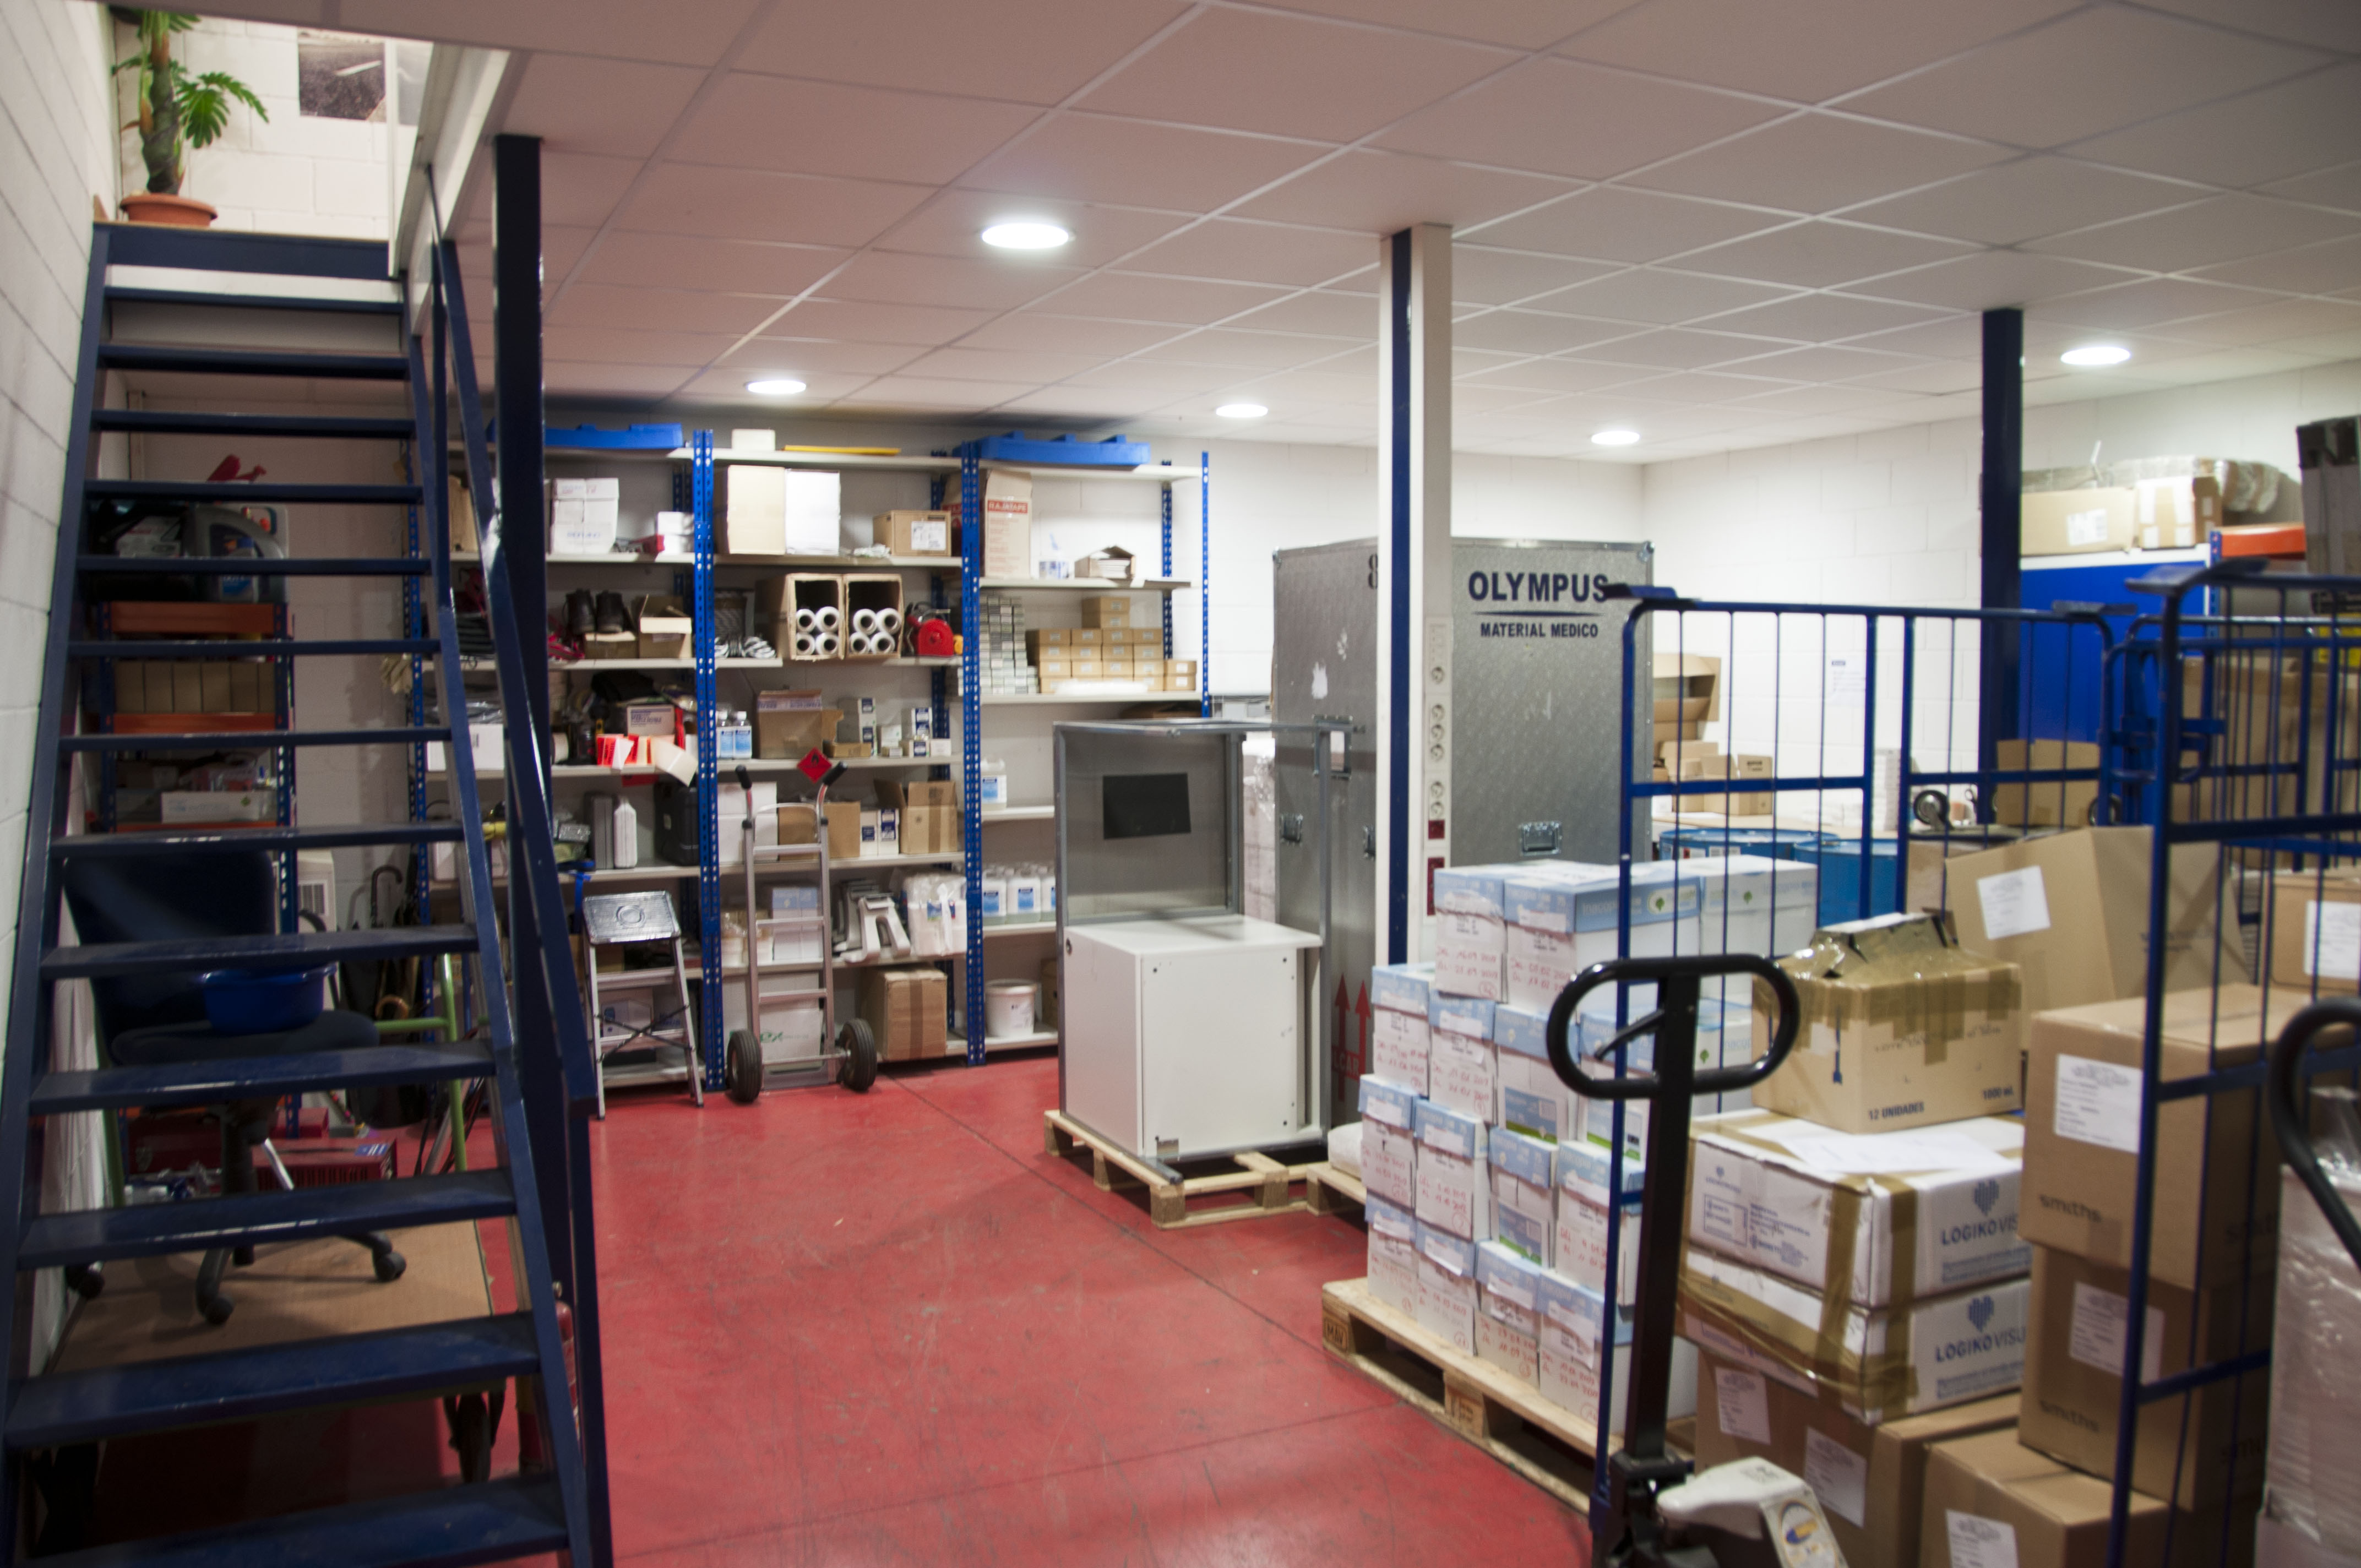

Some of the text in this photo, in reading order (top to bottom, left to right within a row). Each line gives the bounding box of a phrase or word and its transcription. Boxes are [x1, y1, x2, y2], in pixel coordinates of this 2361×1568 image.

[1468, 570, 1609, 603] OLYMPUS
[1480, 622, 1598, 639] MATERIAL MEDICO
[1982, 1087, 2002, 1099] 1000
[1868, 1101, 1925, 1120] 12 UNIDADES
[2038, 1193, 2103, 1224] smiths
